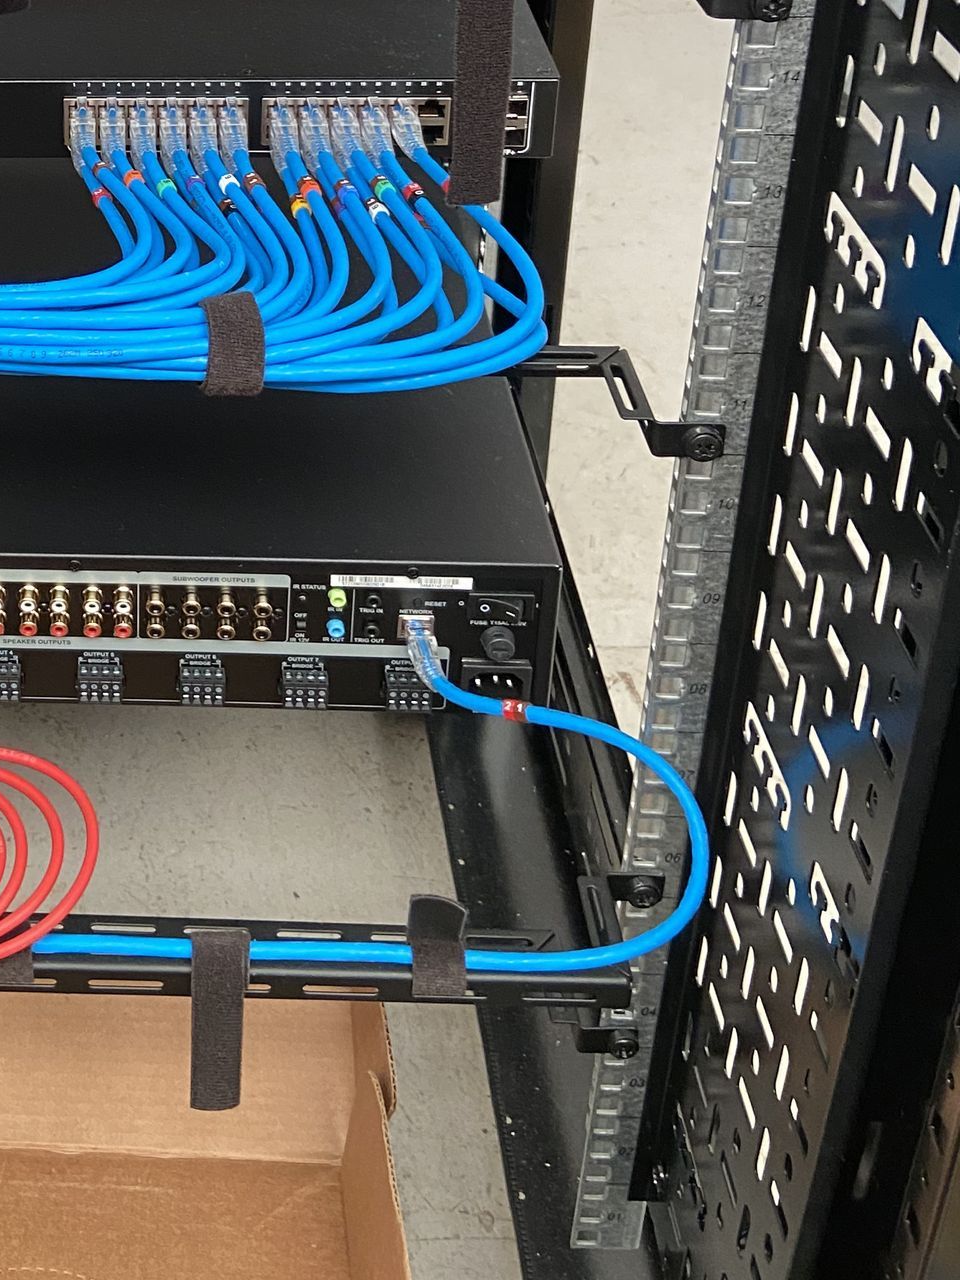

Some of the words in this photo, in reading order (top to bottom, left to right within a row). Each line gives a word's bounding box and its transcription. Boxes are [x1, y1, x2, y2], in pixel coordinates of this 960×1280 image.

[781, 70, 802, 83] 14
[765, 184, 783, 199] 13
[749, 294, 767, 309] 12
[719, 497, 736, 511] 10
[172, 575, 220, 583] SUBWOOFER
[221, 576, 256, 584] OUTPUTS
[424, 600, 447, 608] RESET
[703, 592, 721, 605] 09
[399, 608, 434, 616] NETWORK
[2, 637, 37, 646] SPEAKER
[38, 638, 72, 647] OUTPUTS
[689, 683, 707, 695] 08
[664, 851, 681, 864] 06
